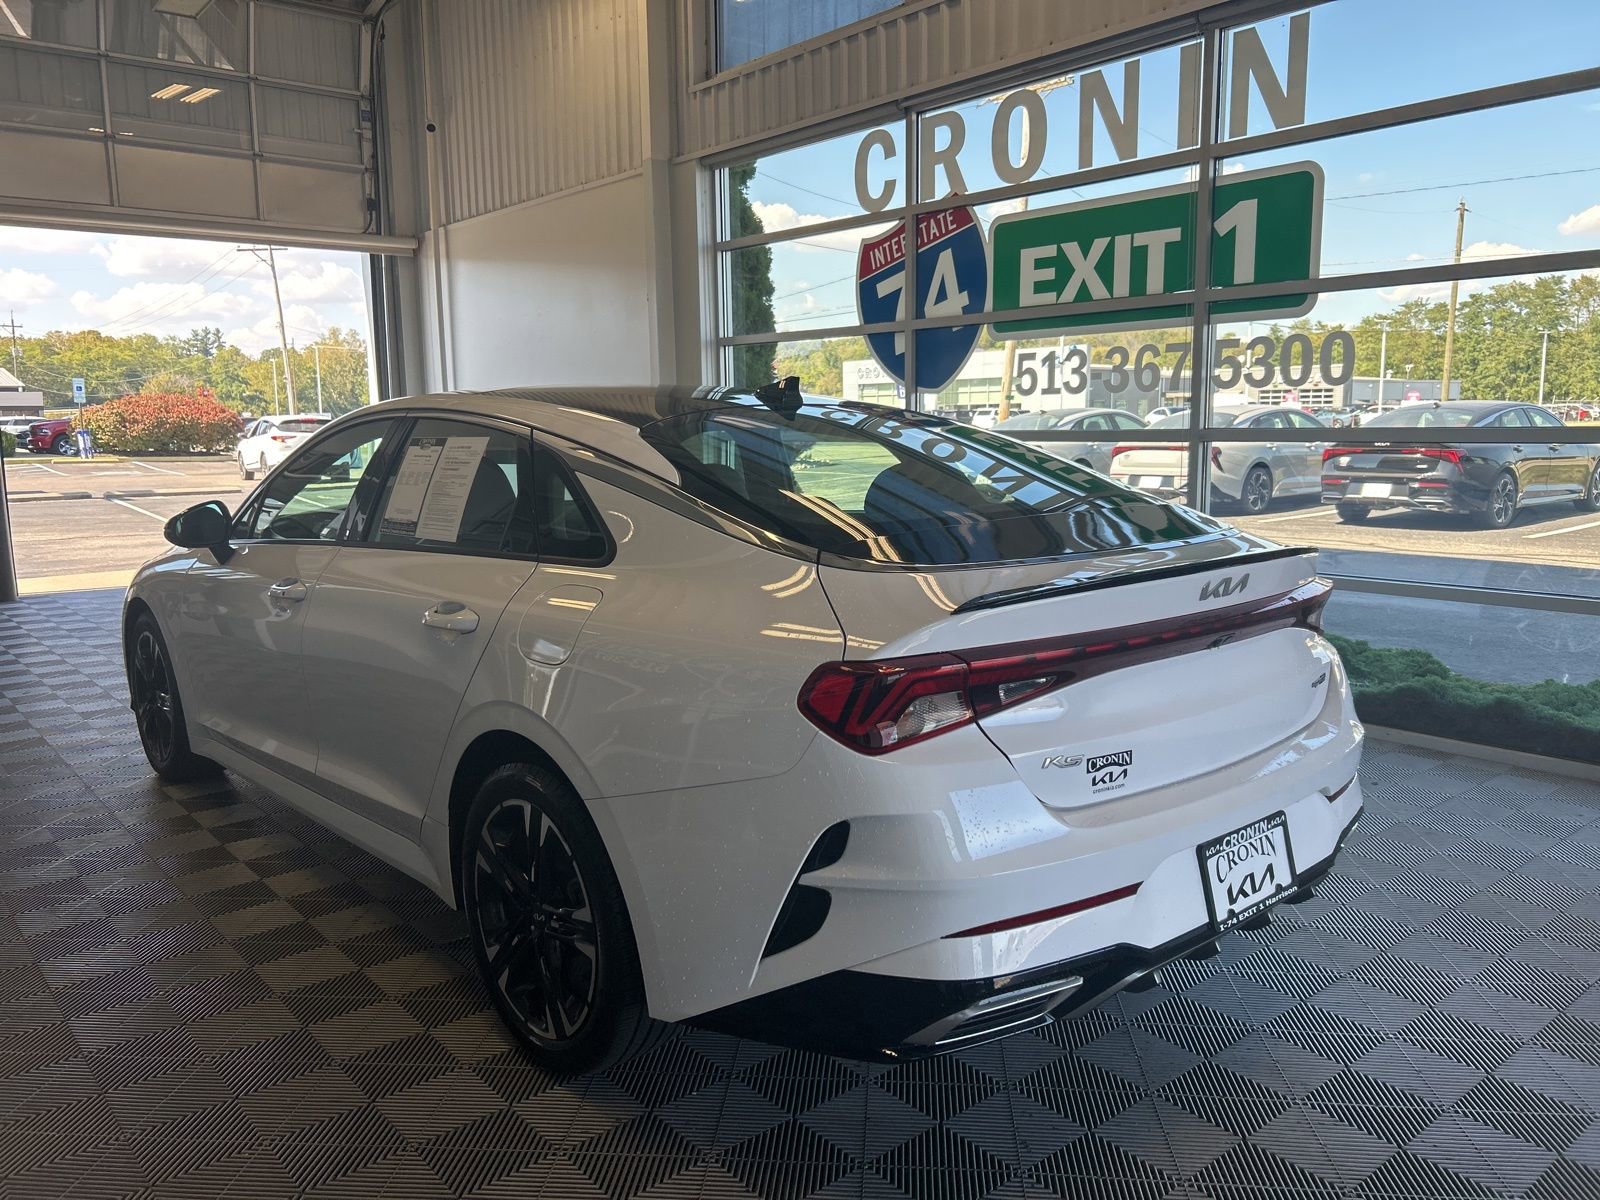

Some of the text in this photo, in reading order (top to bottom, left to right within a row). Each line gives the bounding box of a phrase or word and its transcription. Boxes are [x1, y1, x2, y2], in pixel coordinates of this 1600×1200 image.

[854, 11, 1311, 212] CRONIN
[1019, 198, 1258, 307] EXIT 1
[876, 248, 970, 356] 74
[1015, 331, 1356, 397] 513 367 5300
[1199, 573, 1250, 601] KIA
[1041, 754, 1085, 769] K5
[1088, 752, 1130, 773] CRONIN
[1092, 768, 1127, 787] KIA
[1092, 783, 1125, 795] croninkia.com
[1222, 819, 1268, 851] CRONIN
[1216, 831, 1277, 884] CRONIN
[1227, 862, 1275, 906] KIA
[1219, 917, 1238, 931] I-74
[1239, 907, 1258, 920] EXIT
[1266, 886, 1298, 906] Harrison
